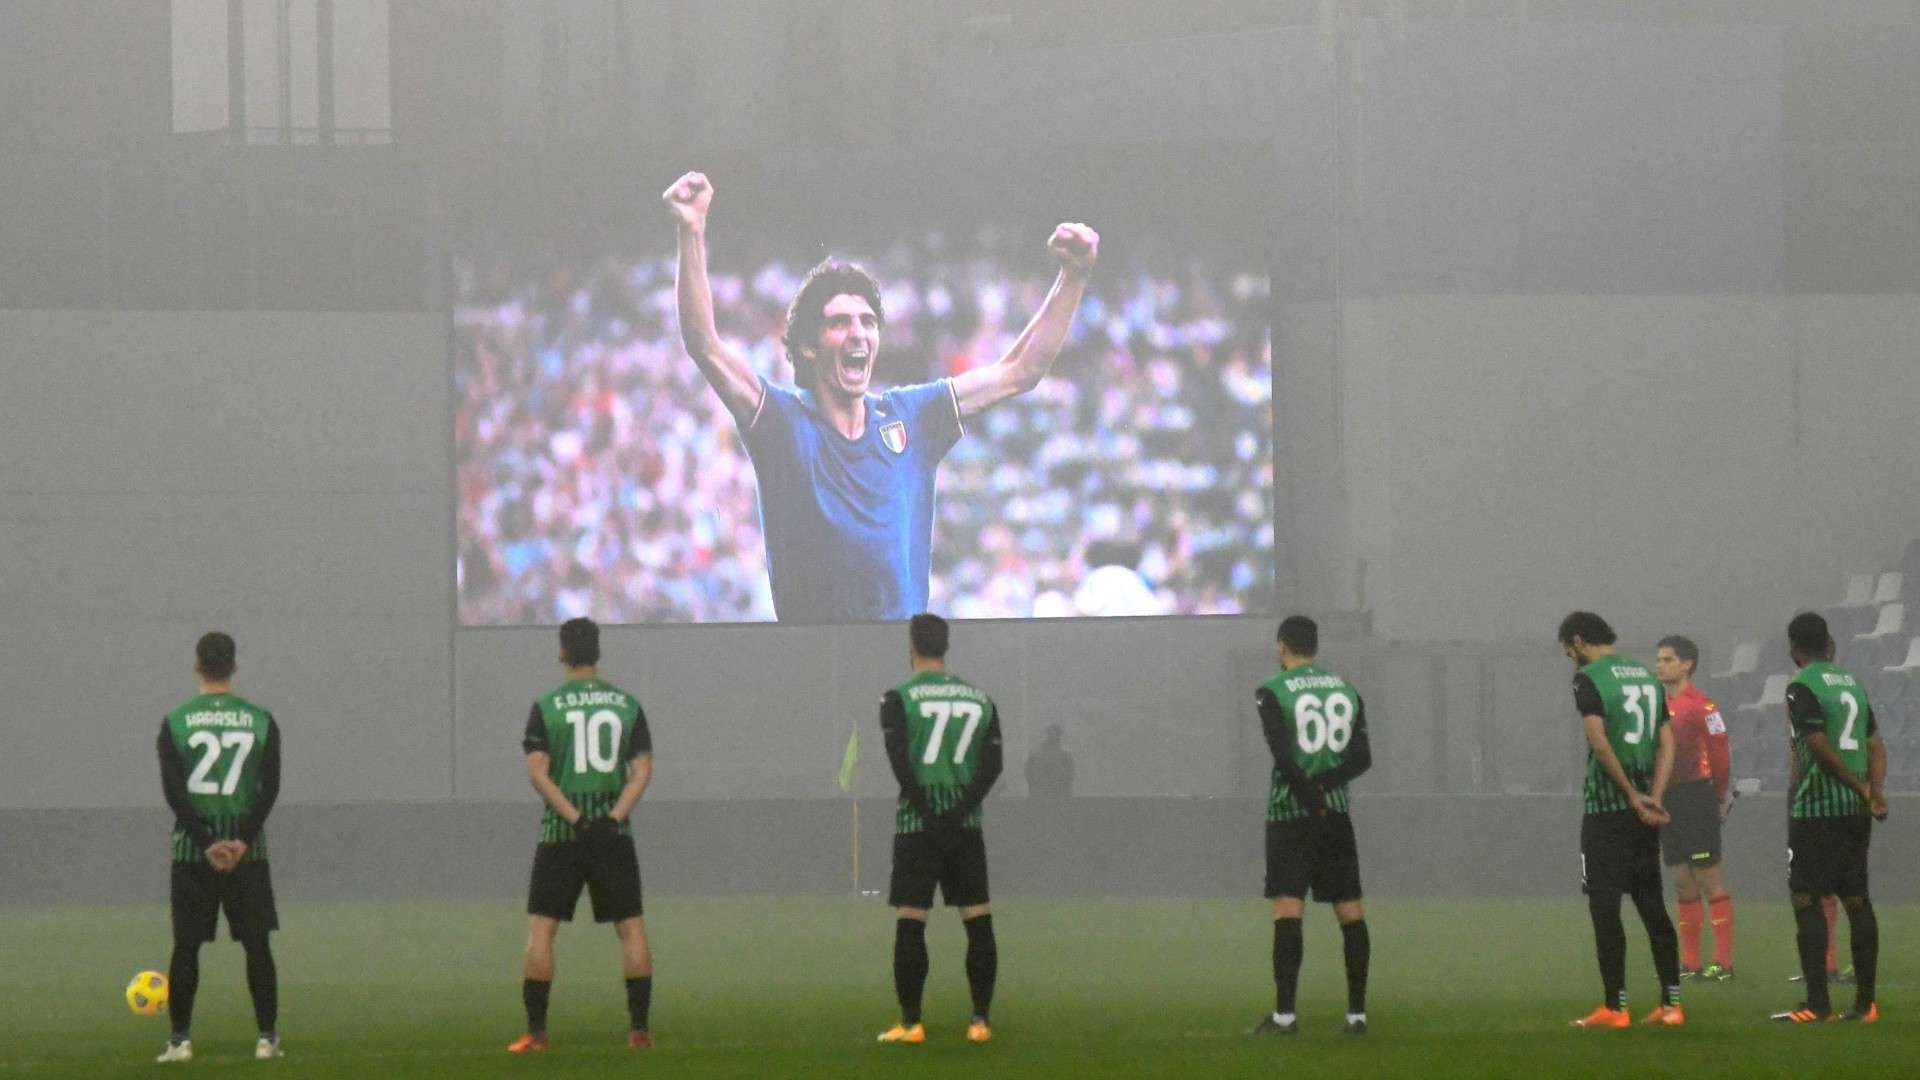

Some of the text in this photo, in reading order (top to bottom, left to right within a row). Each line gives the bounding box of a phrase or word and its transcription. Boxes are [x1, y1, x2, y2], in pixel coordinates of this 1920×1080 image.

[565, 709, 622, 774] 10
[920, 701, 983, 763] 77
[1295, 692, 1353, 754] 68
[1622, 685, 1657, 744] 31
[1839, 691, 1859, 751] 2
[187, 730, 255, 795] 27
